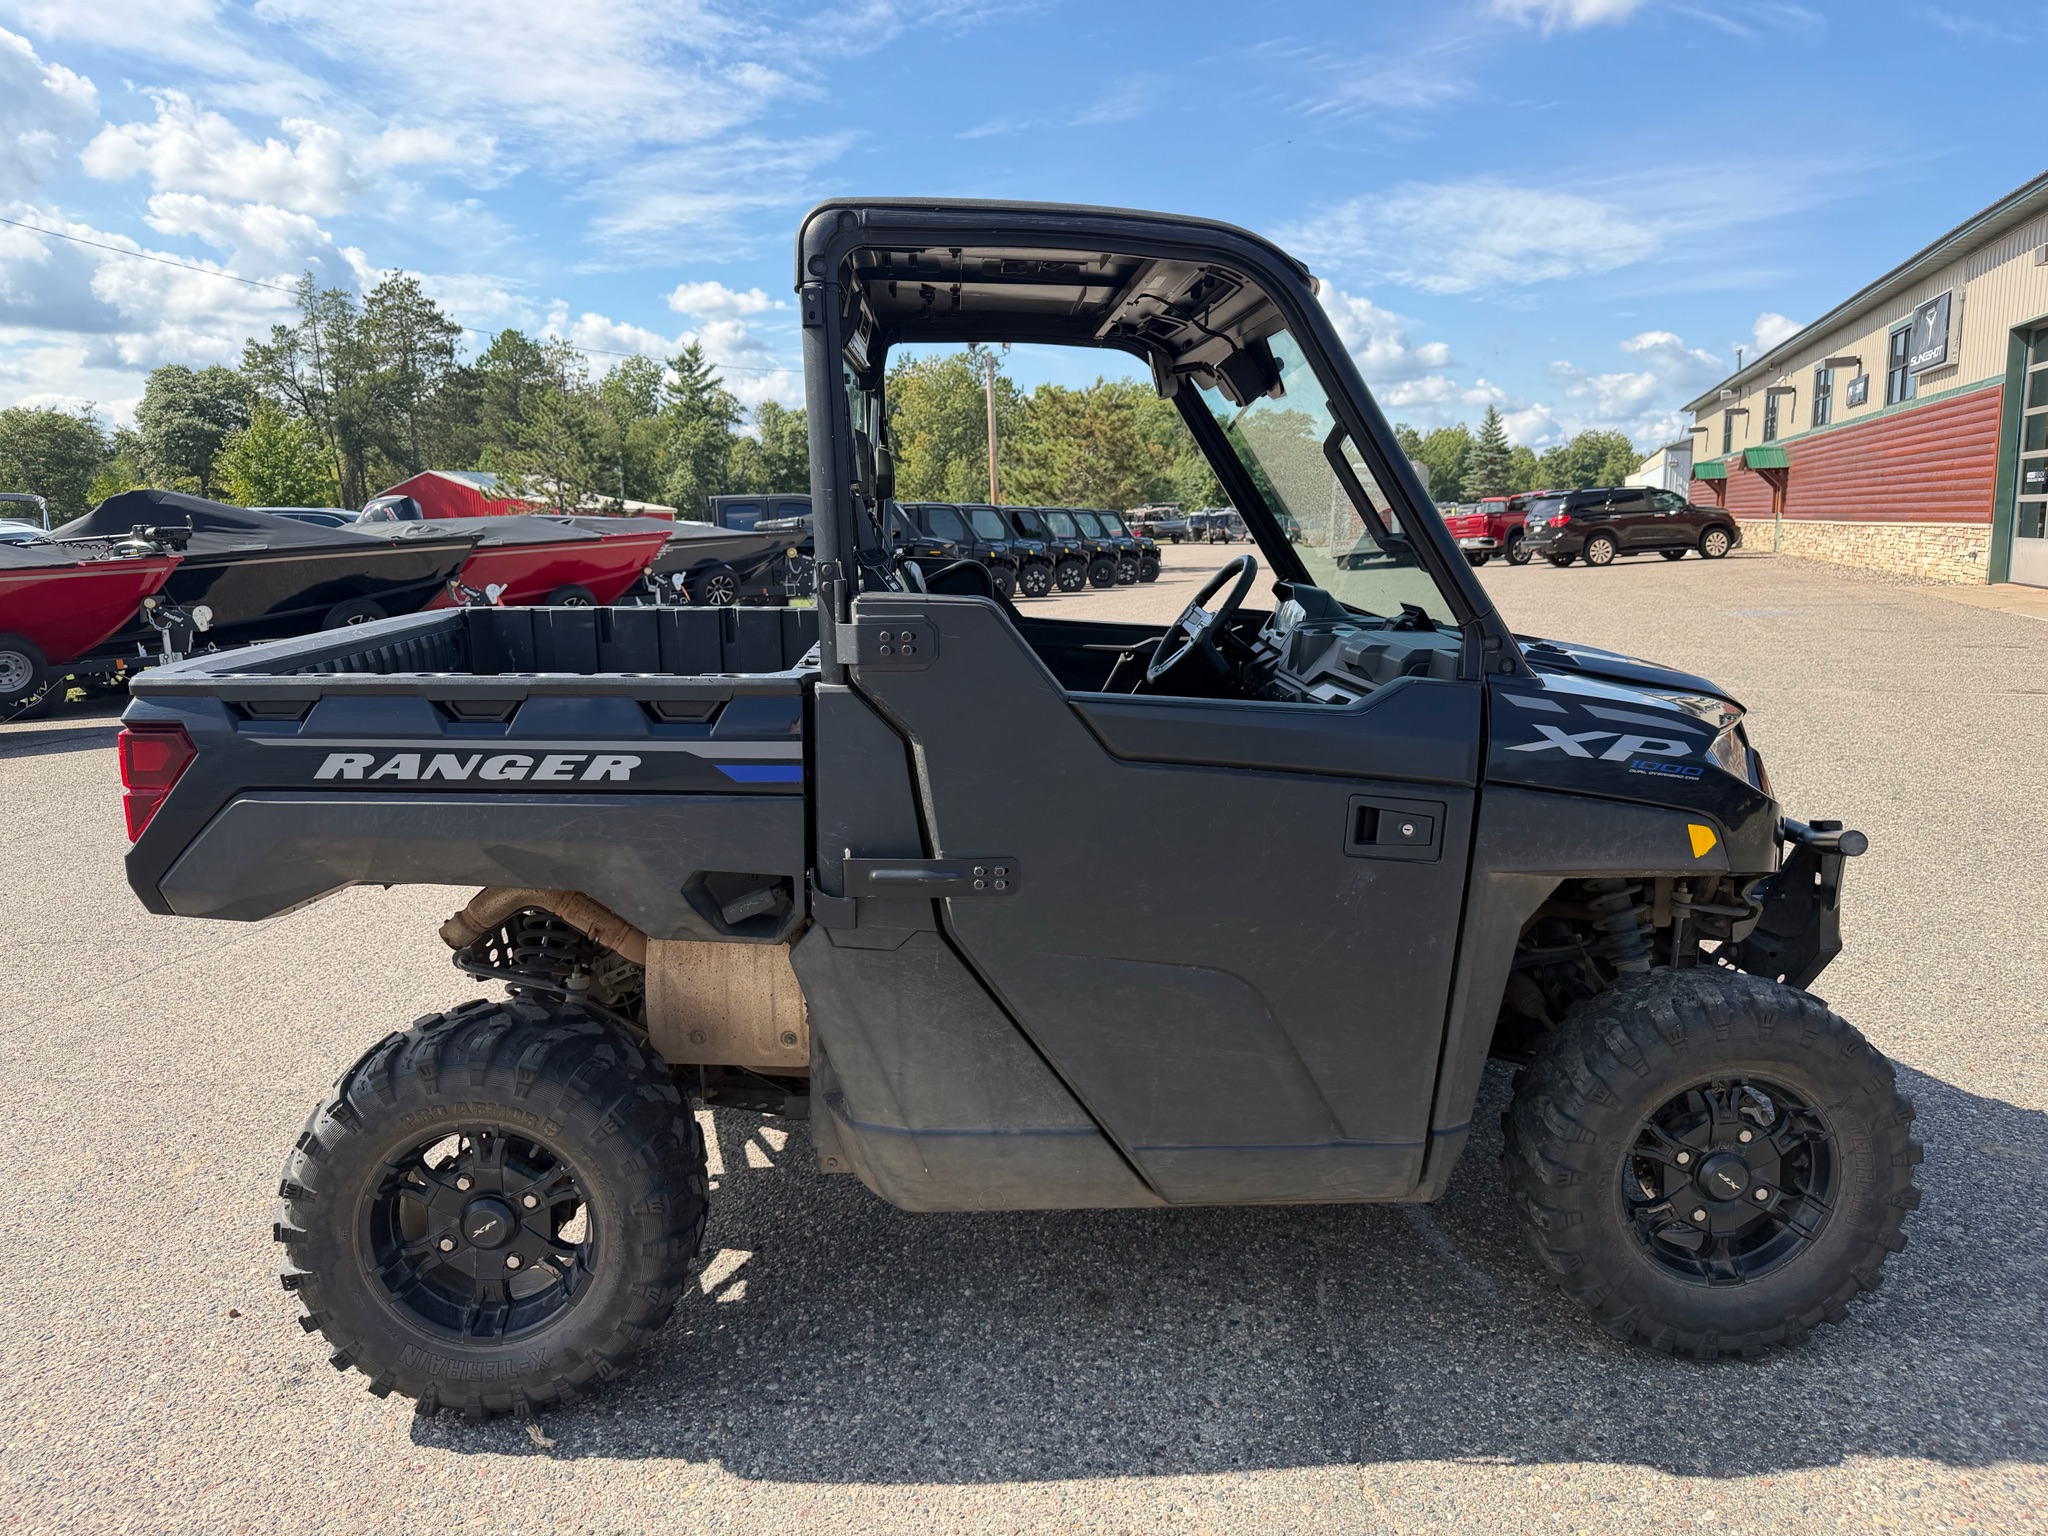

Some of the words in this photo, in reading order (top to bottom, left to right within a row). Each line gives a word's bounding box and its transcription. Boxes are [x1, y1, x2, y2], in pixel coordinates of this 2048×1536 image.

[1910, 345, 1943, 367] SLINGSHOT
[1504, 723, 1693, 762] XP
[313, 753, 641, 781] RANGER
[1630, 759, 1704, 776] 1000
[1648, 771, 1685, 780] OVERHEAD
[399, 1104, 449, 1128] PRO
[455, 1101, 540, 1128] ARMOR
[1717, 1172, 1741, 1190] XP
[472, 1219, 498, 1238] XP
[397, 1342, 551, 1382] X-TERRAIN
